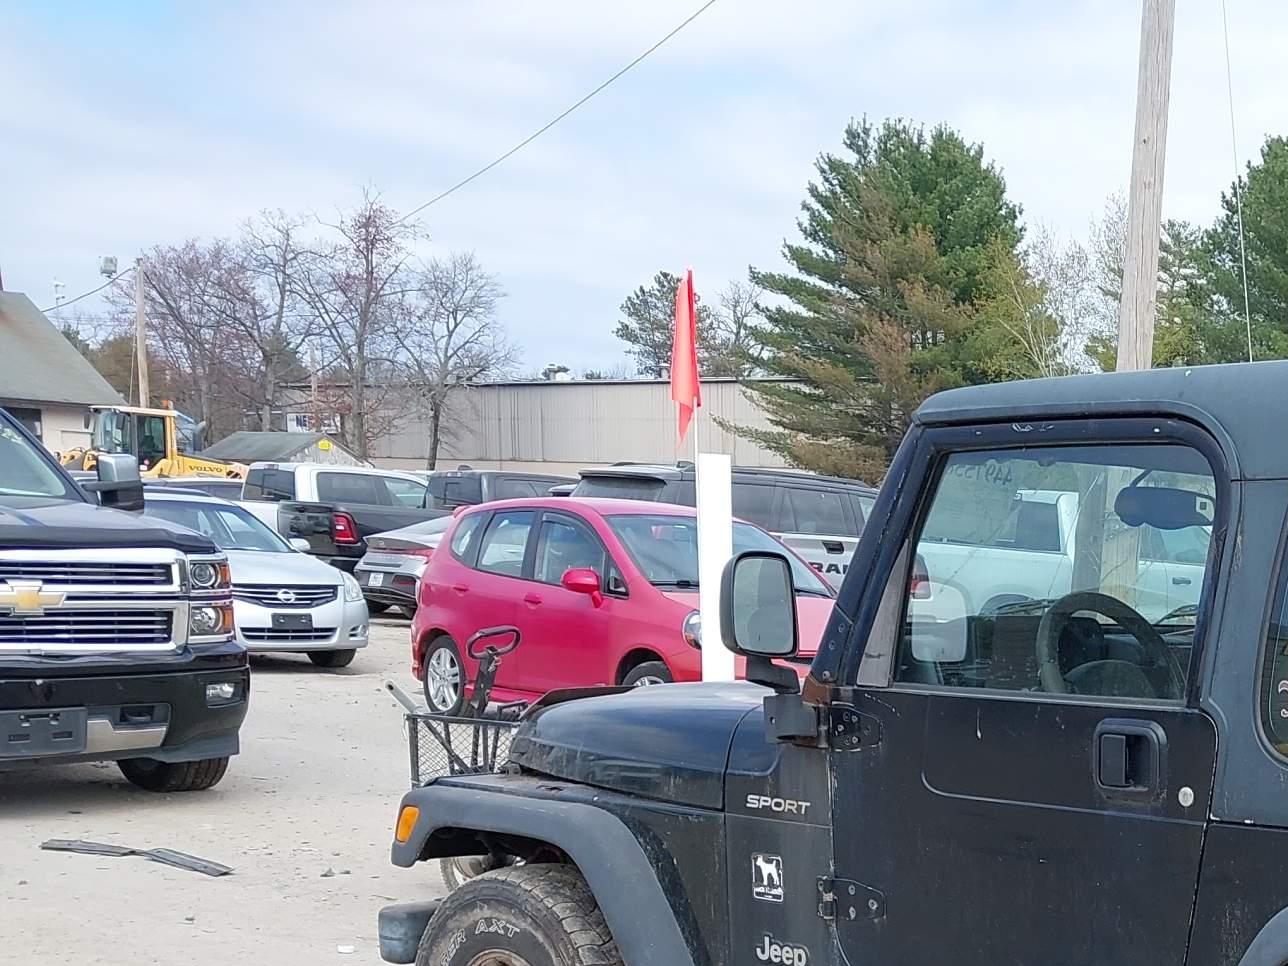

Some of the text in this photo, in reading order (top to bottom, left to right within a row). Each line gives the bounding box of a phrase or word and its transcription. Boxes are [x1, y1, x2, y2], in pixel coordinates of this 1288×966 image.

[188, 465, 224, 473] VOLVO
[745, 794, 811, 815] SPORT
[475, 918, 521, 938] AXT
